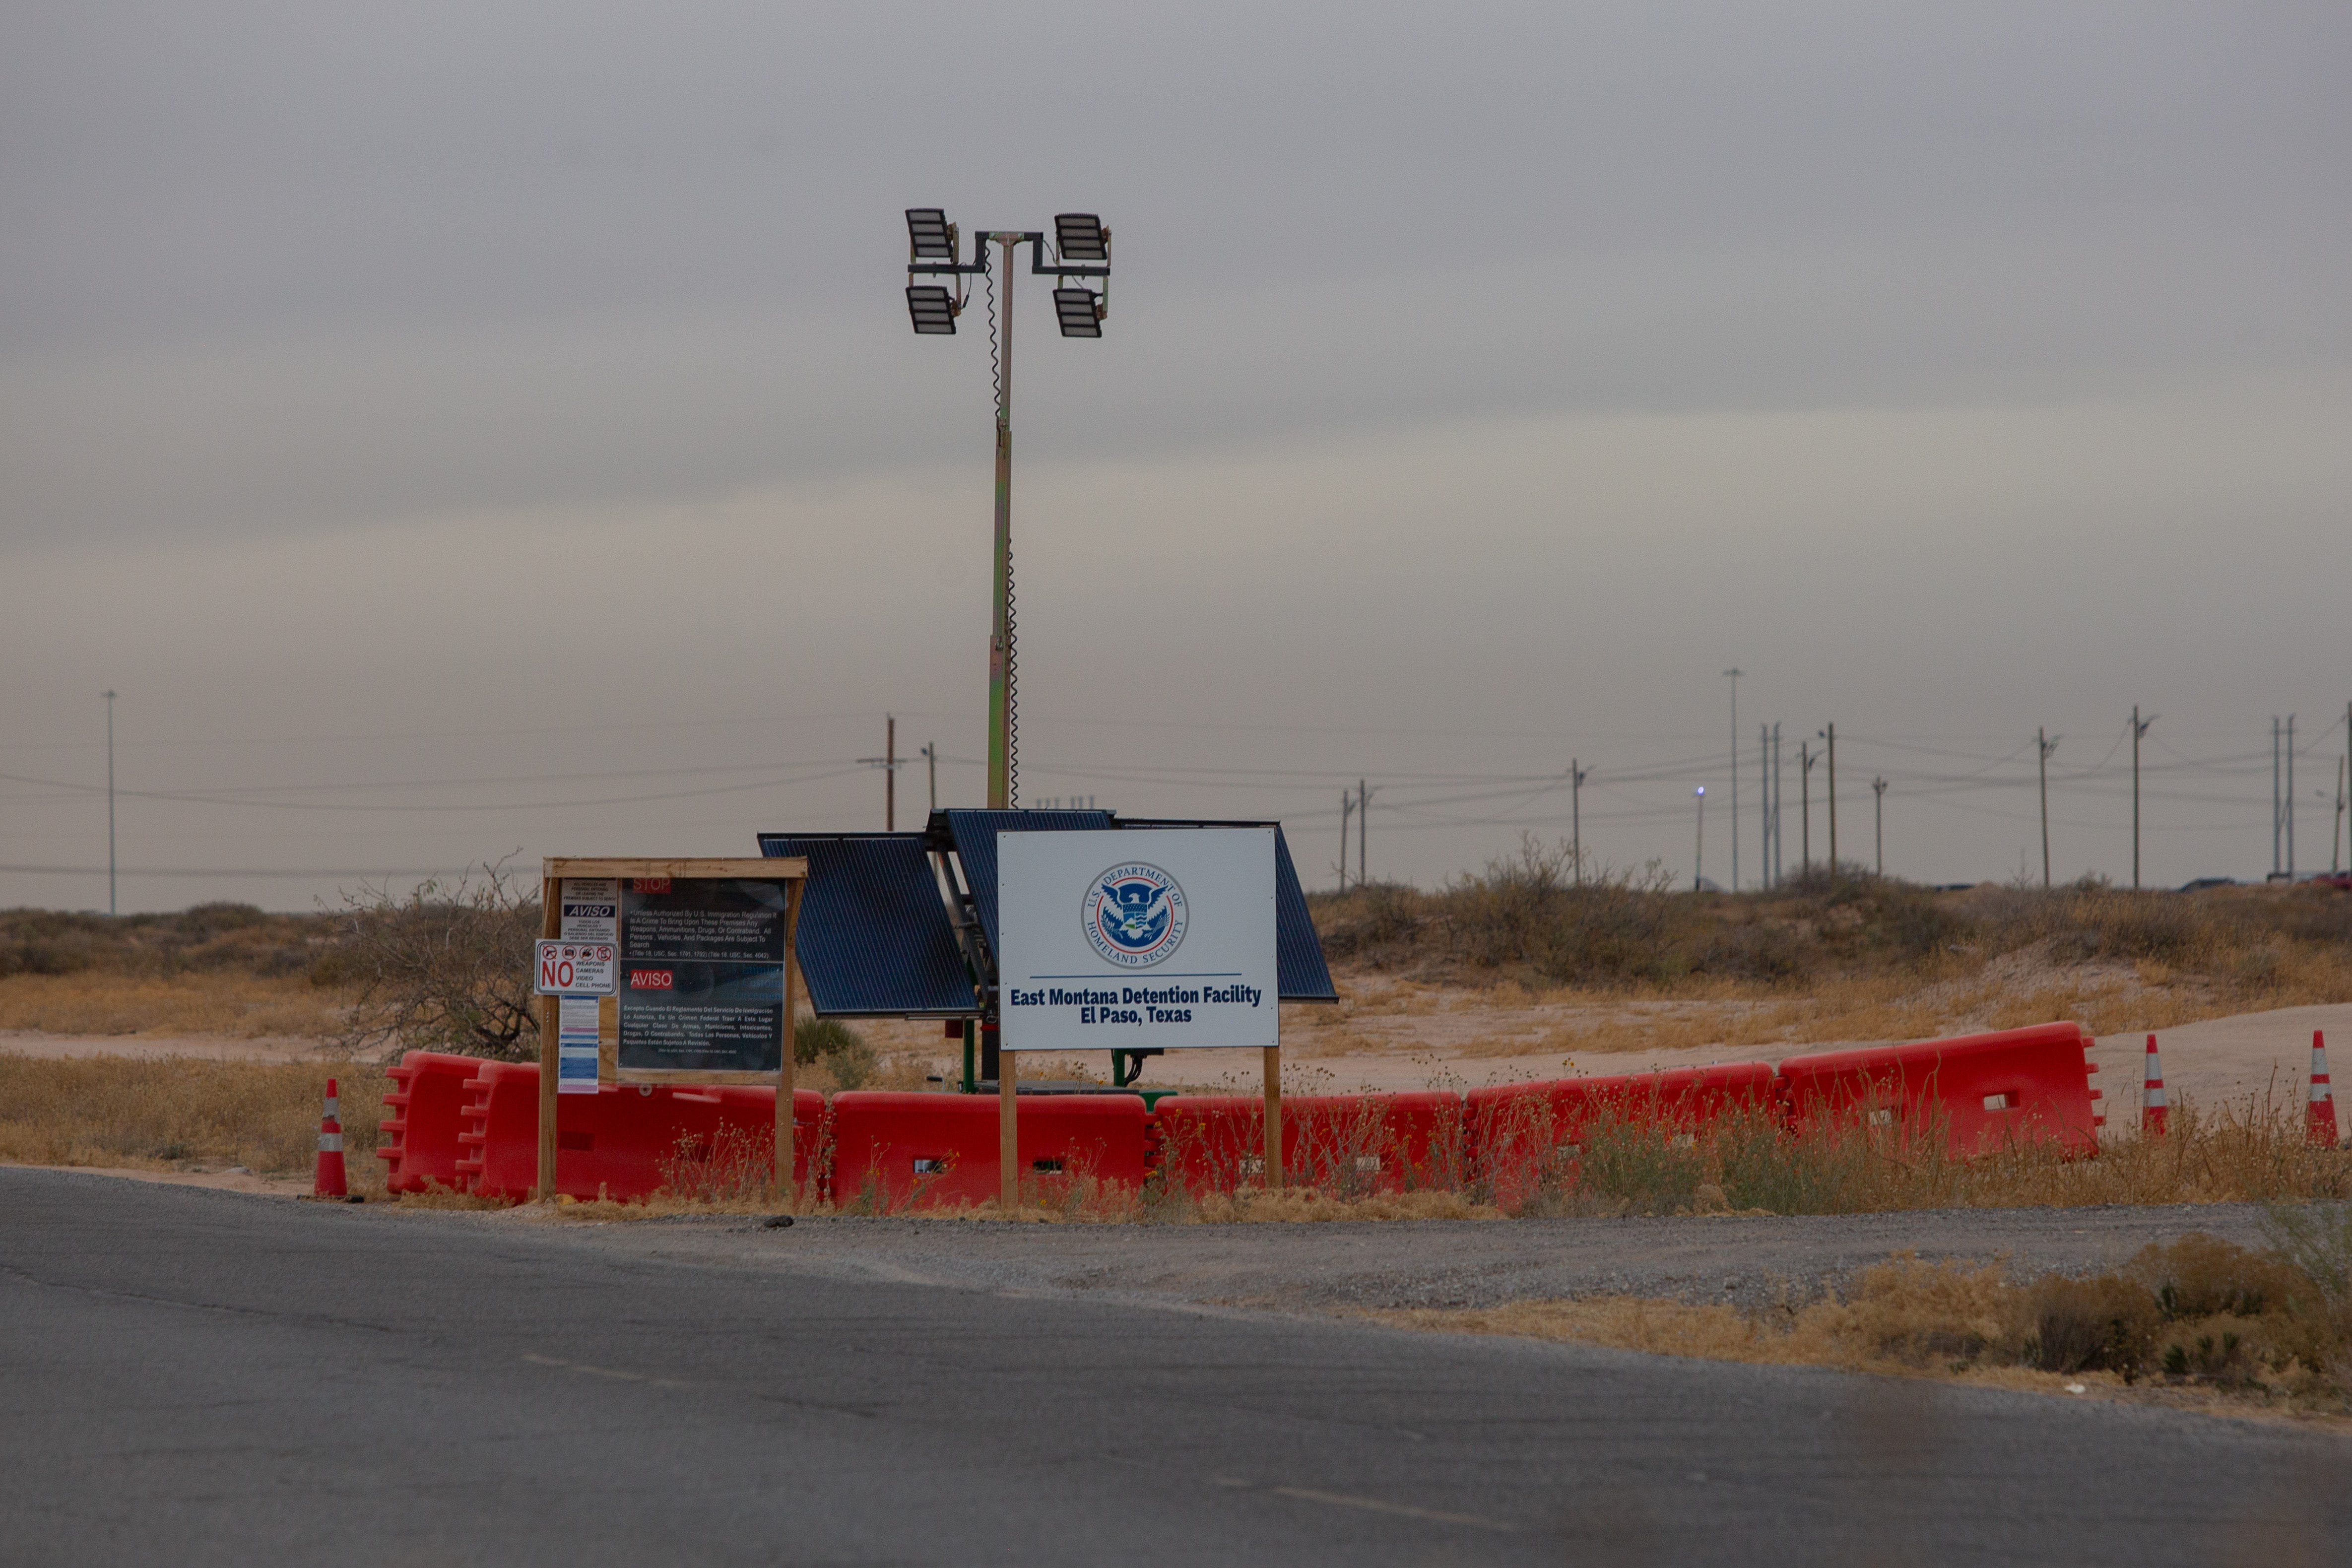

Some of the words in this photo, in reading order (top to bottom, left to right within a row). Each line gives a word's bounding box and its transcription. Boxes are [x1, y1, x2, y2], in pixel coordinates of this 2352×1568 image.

[634, 878, 669, 890] STOP
[1088, 891, 1102, 908] U.S.
[1104, 867, 1176, 892] DEPARTMENT
[1172, 893, 1183, 907] OF
[569, 906, 609, 916] AVISO
[1088, 922, 1138, 964] HOMELAND
[1142, 920, 1183, 963] SECURITY
[542, 961, 573, 986] NO
[631, 973, 672, 986] AVISO
[1010, 988, 1045, 1006] East
[1049, 987, 1119, 1005] Montana
[1122, 985, 1199, 1004] Detention
[1203, 984, 1262, 1008] Facility
[1081, 1006, 1097, 1024] El
[1100, 1007, 1143, 1027] Paso,
[1146, 1006, 1192, 1023] Texas
